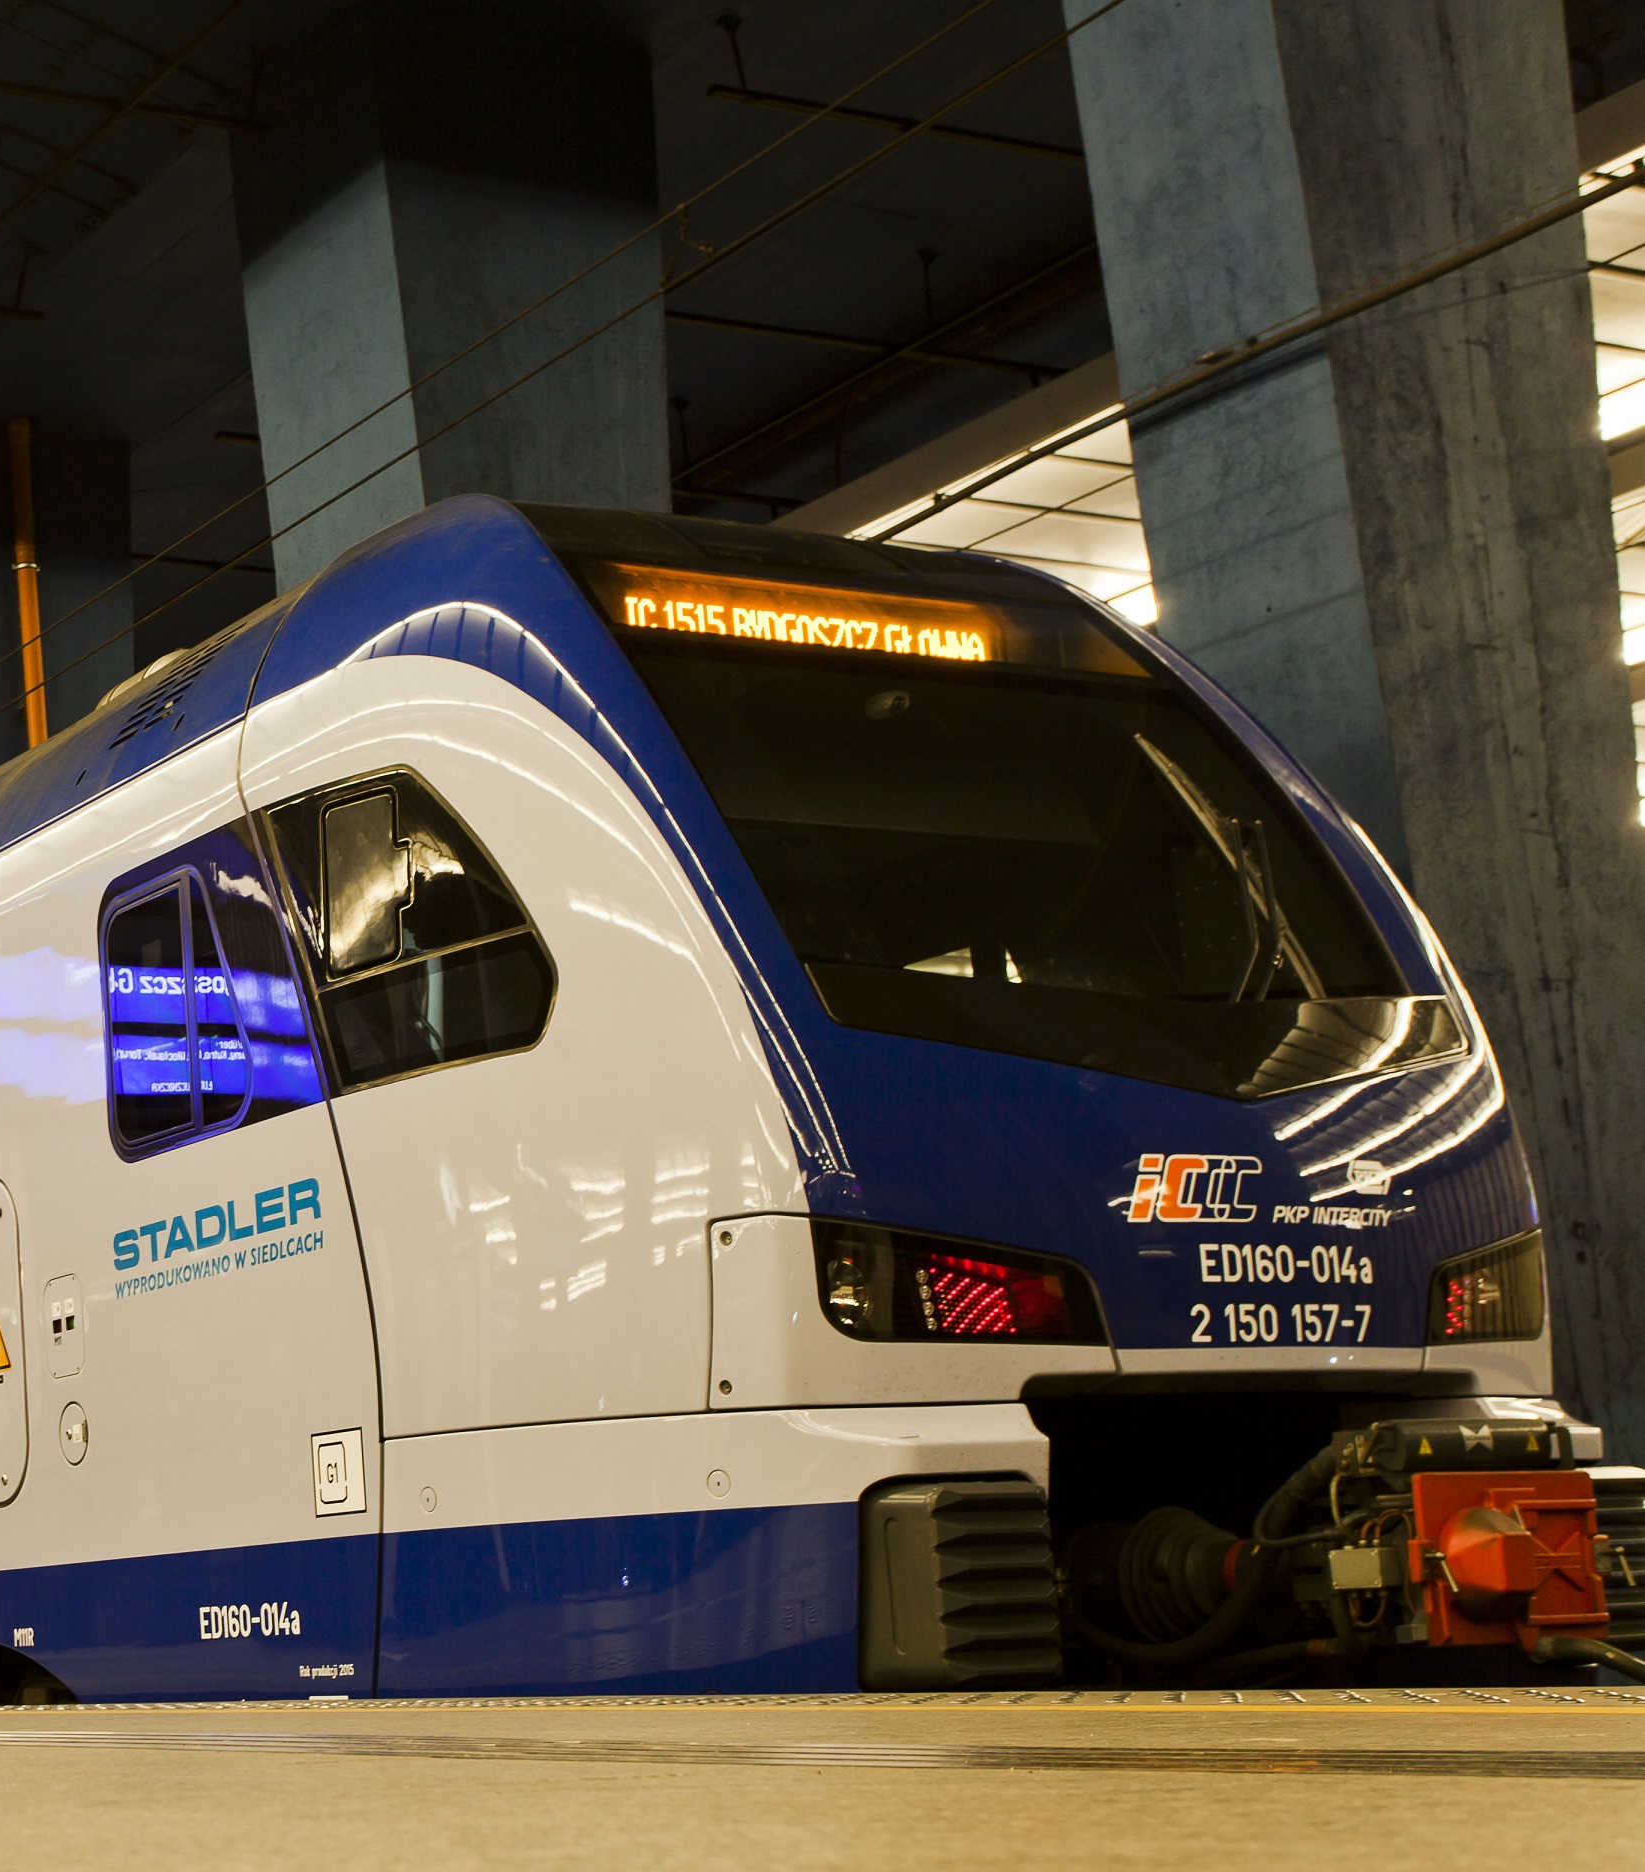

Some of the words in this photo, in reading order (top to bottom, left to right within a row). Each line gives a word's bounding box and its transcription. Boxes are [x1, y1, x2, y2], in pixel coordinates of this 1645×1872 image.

[663, 600, 726, 635] 1515
[732, 607, 878, 649] BYDGOSZCZ
[113, 1177, 321, 1271] STADLER
[1272, 1205, 1309, 1224] PKP
[1312, 1206, 1392, 1227] INTERCITY
[115, 1254, 230, 1300] WYPRODUKOWANO
[234, 1250, 247, 1270] W
[251, 1230, 323, 1266] SIEDLCACH
[1199, 1243, 1373, 1284] ED160-014a
[1189, 1304, 1212, 1343] 2
[1224, 1304, 1278, 1343] 150
[1291, 1304, 1372, 1343] 157-7
[327, 1462, 338, 1483] G1
[199, 1601, 301, 1639] ED160-014a
